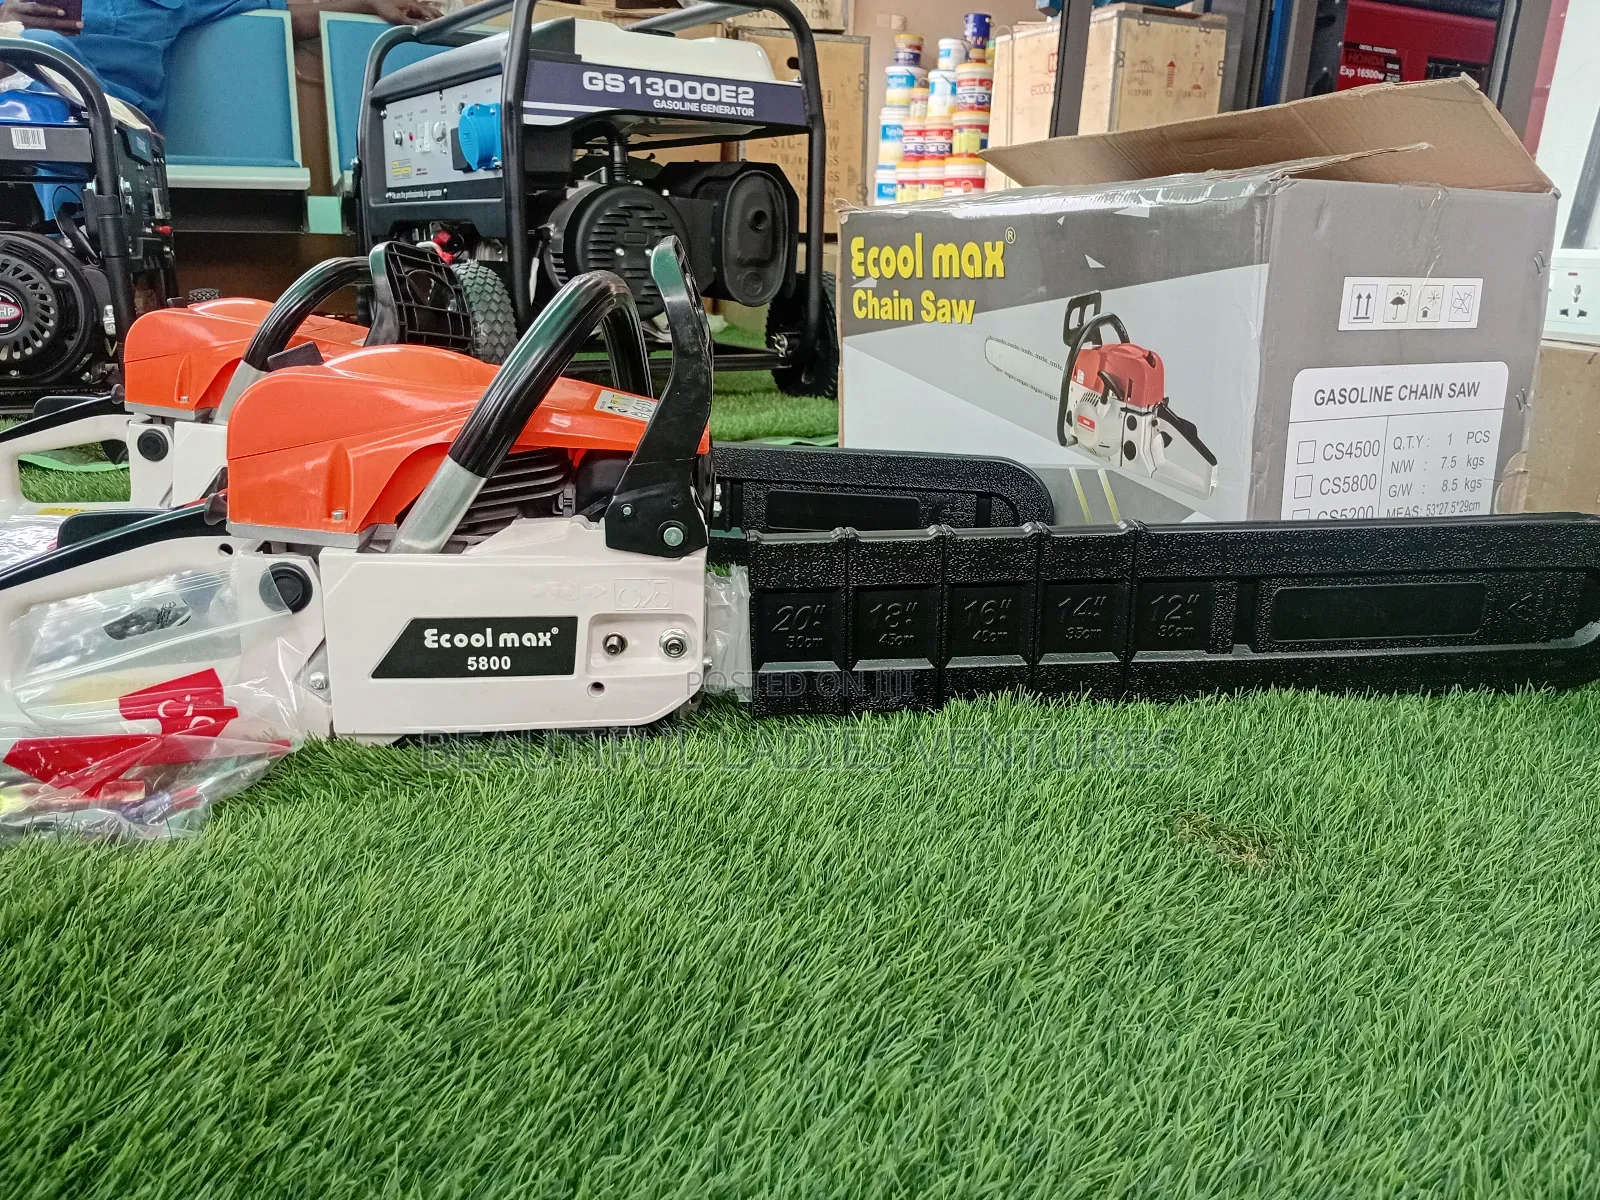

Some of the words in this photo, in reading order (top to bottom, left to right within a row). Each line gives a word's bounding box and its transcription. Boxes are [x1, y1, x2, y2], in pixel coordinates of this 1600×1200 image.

[1340, 65, 1355, 78] Exp
[582, 71, 755, 105] GS13000E2
[653, 99, 700, 112] GASOLINE
[700, 103, 755, 117] GENERATOR
[850, 232, 924, 279] Ecool
[852, 288, 914, 321] Chain
[920, 289, 976, 324] Saw
[1313, 385, 1394, 406] GASOLINE
[1398, 383, 1444, 401] CHAIN
[1447, 381, 1481, 398] SAW
[1447, 432, 1453, 446] 1
[1466, 430, 1491, 444] PCS
[1322, 439, 1380, 461] CS4500
[1441, 456, 1457, 469] 7.5
[1466, 454, 1485, 470] kgs
[1319, 473, 1377, 496] CS5800
[1441, 478, 1458, 492] 8.5
[1464, 477, 1483, 493] kgs
[1386, 506, 1423, 518] MEAS:
[423, 627, 493, 649] Ecool
[467, 655, 511, 671] 5800
